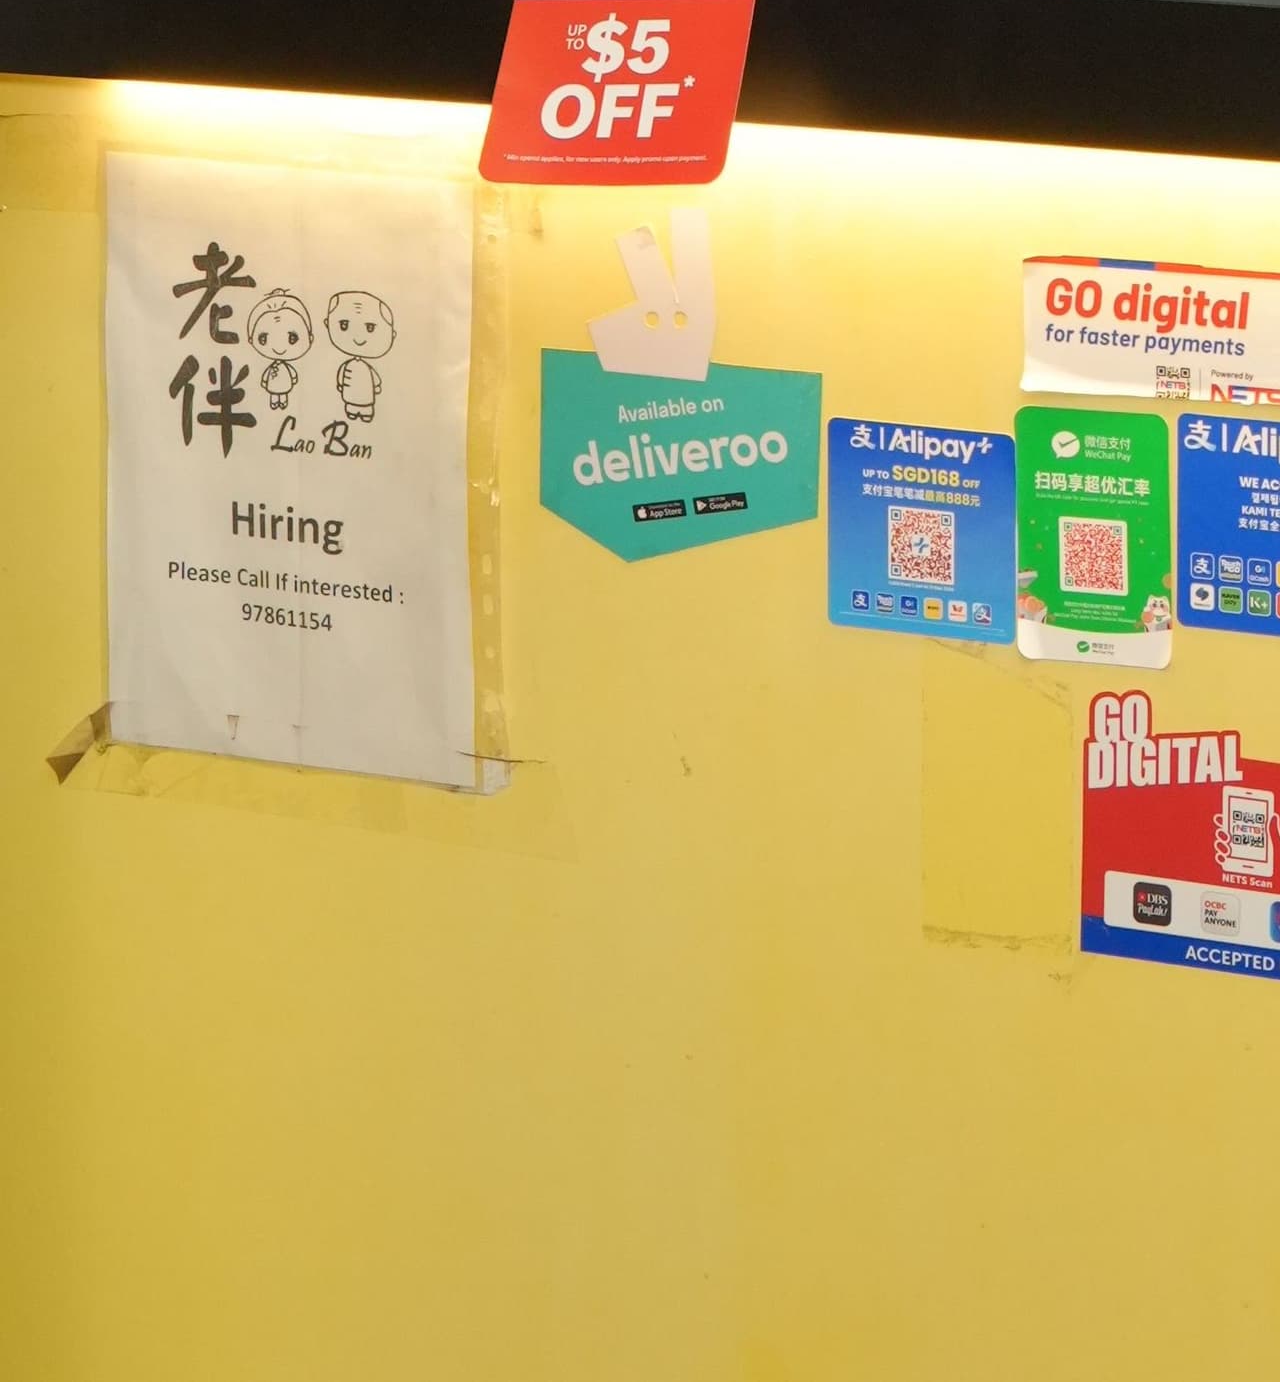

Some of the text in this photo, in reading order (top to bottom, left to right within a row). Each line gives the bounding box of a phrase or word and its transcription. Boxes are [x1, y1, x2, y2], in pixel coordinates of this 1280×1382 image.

[565, 37, 585, 50] TO
[567, 12, 671, 84] UP $5
[1045, 277, 1250, 335] GO digital
[168, 241, 258, 459] 老伴
[1045, 323, 1245, 357] for faster payments
[1211, 368, 1253, 382] Powered by
[617, 396, 725, 425] Available on
[270, 414, 374, 461] Lao Ban
[572, 430, 789, 488] deliveroo
[1085, 449, 1113, 461] WeChat
[863, 464, 980, 490] UP TO SGD168 OFF
[1034, 470, 1151, 497] 扫码享超优汇率
[1239, 475, 1260, 490] WE
[1241, 505, 1268, 519] KAMI
[230, 500, 345, 556] Hiring
[167, 560, 394, 604] Please Call If interested
[240, 602, 333, 633] 97861154
[1094, 693, 1149, 744] GO
[1087, 735, 1243, 789] DIGITAL
[1222, 873, 1273, 889] NETS Scan
[1204, 900, 1227, 910] OCBC
[1204, 909, 1217, 917] PAY
[1204, 917, 1237, 928] ANYONE
[1185, 945, 1275, 972] ACCEPTED
